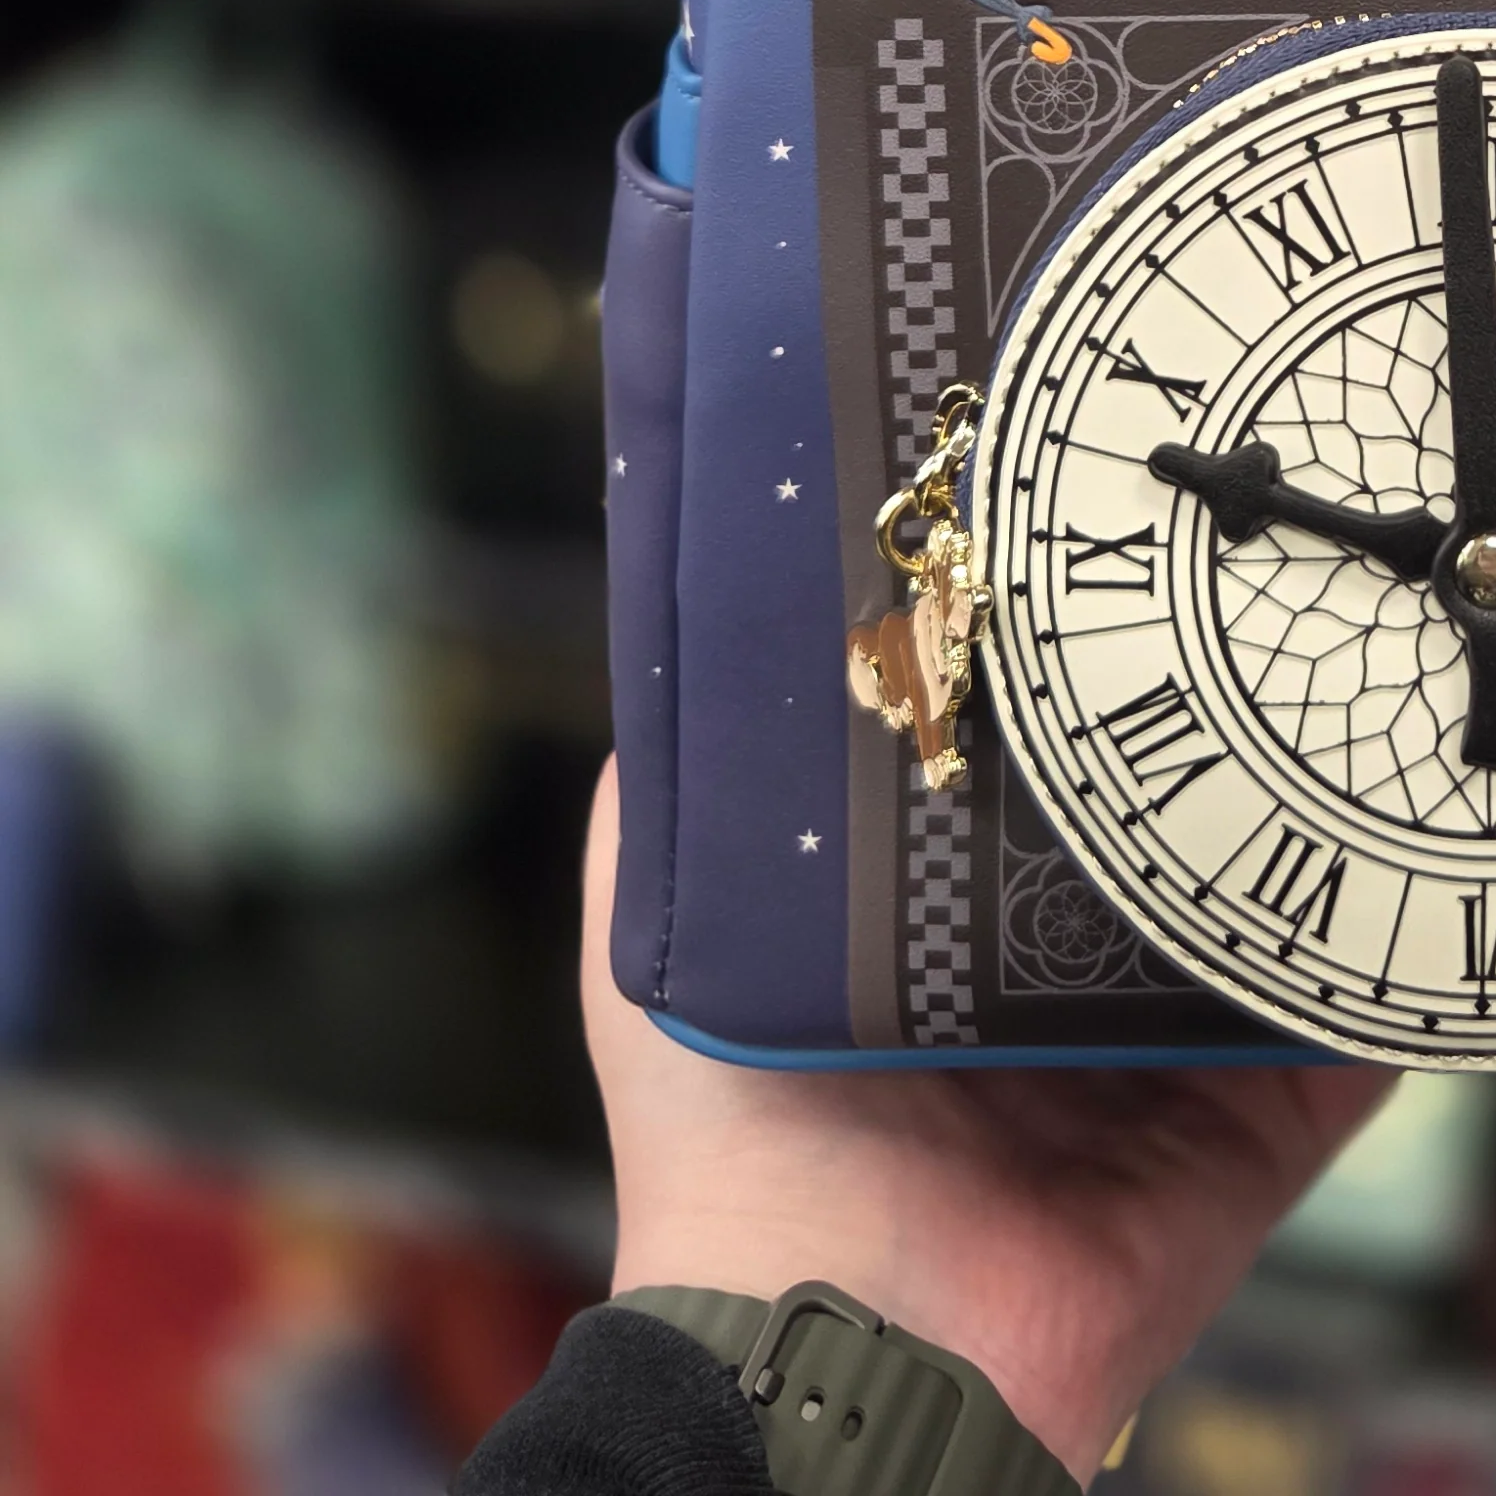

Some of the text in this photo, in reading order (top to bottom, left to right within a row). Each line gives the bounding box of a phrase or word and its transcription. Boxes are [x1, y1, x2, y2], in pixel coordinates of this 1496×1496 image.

[1242, 178, 1351, 291] XI
[1105, 337, 1207, 423] X
[1065, 522, 1155, 597] IX
[1095, 672, 1222, 816] VIII
[1241, 822, 1347, 944] VII
